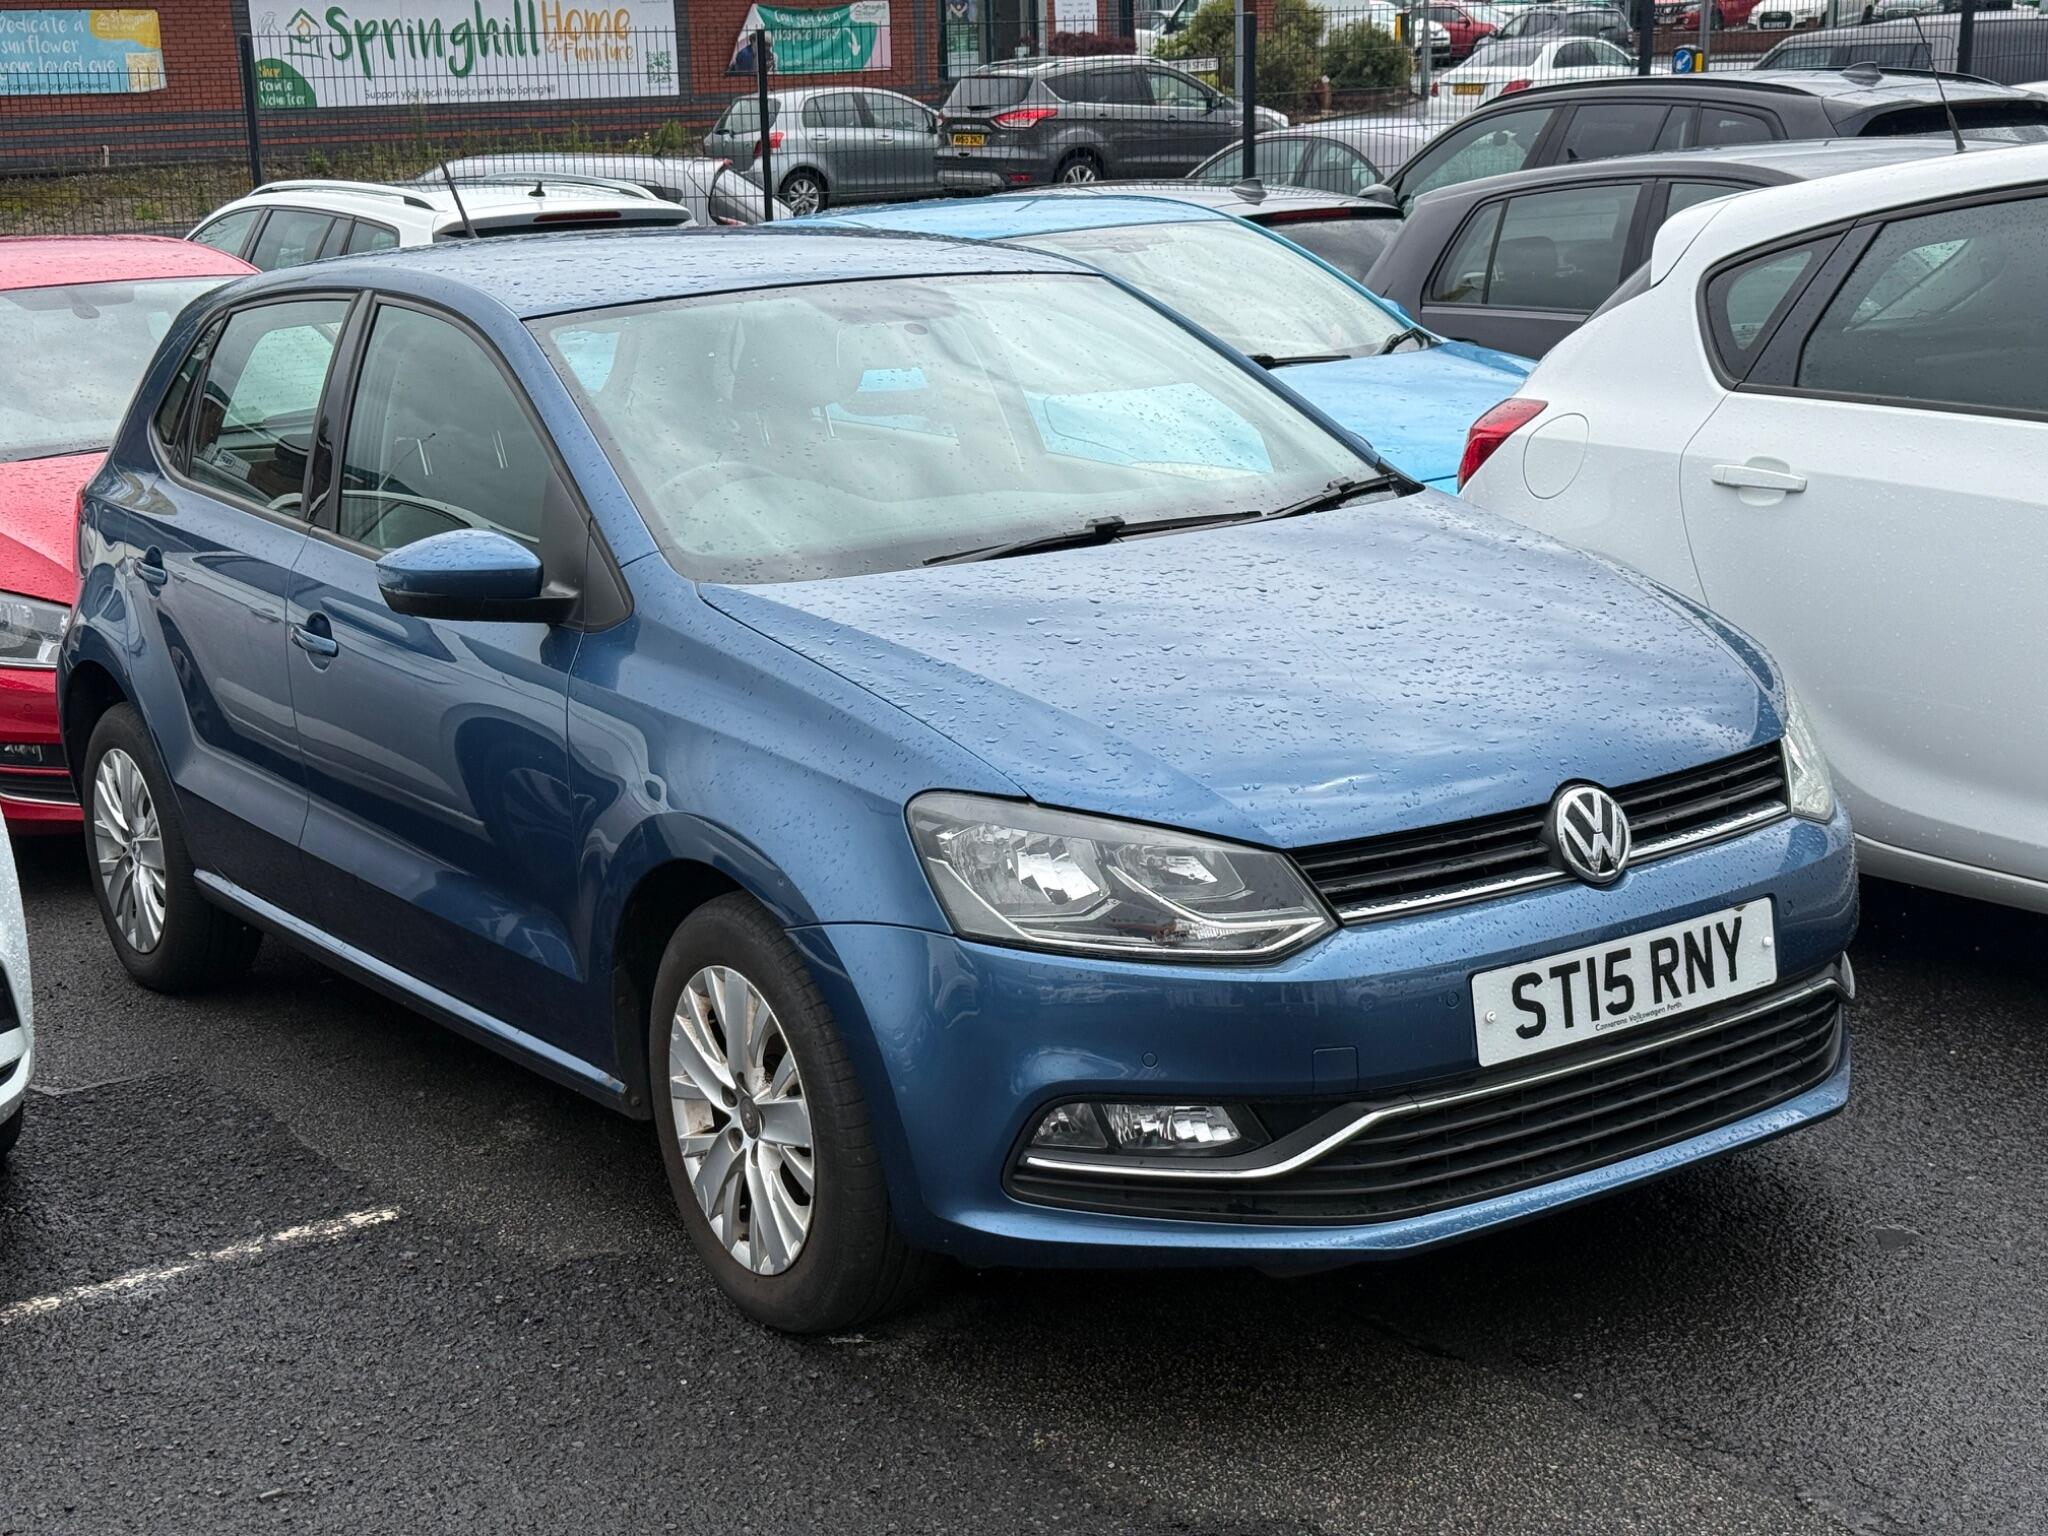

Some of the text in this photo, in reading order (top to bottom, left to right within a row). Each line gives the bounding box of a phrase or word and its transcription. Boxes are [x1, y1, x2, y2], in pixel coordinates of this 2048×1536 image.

[73, 18, 85, 33] a
[325, 0, 632, 81] Springhill Home
[1, 34, 80, 54] sunflower
[1511, 916, 1742, 1040] ST15 RNY
[1595, 1001, 1683, 1032] Camerons Volkswagen Perth
